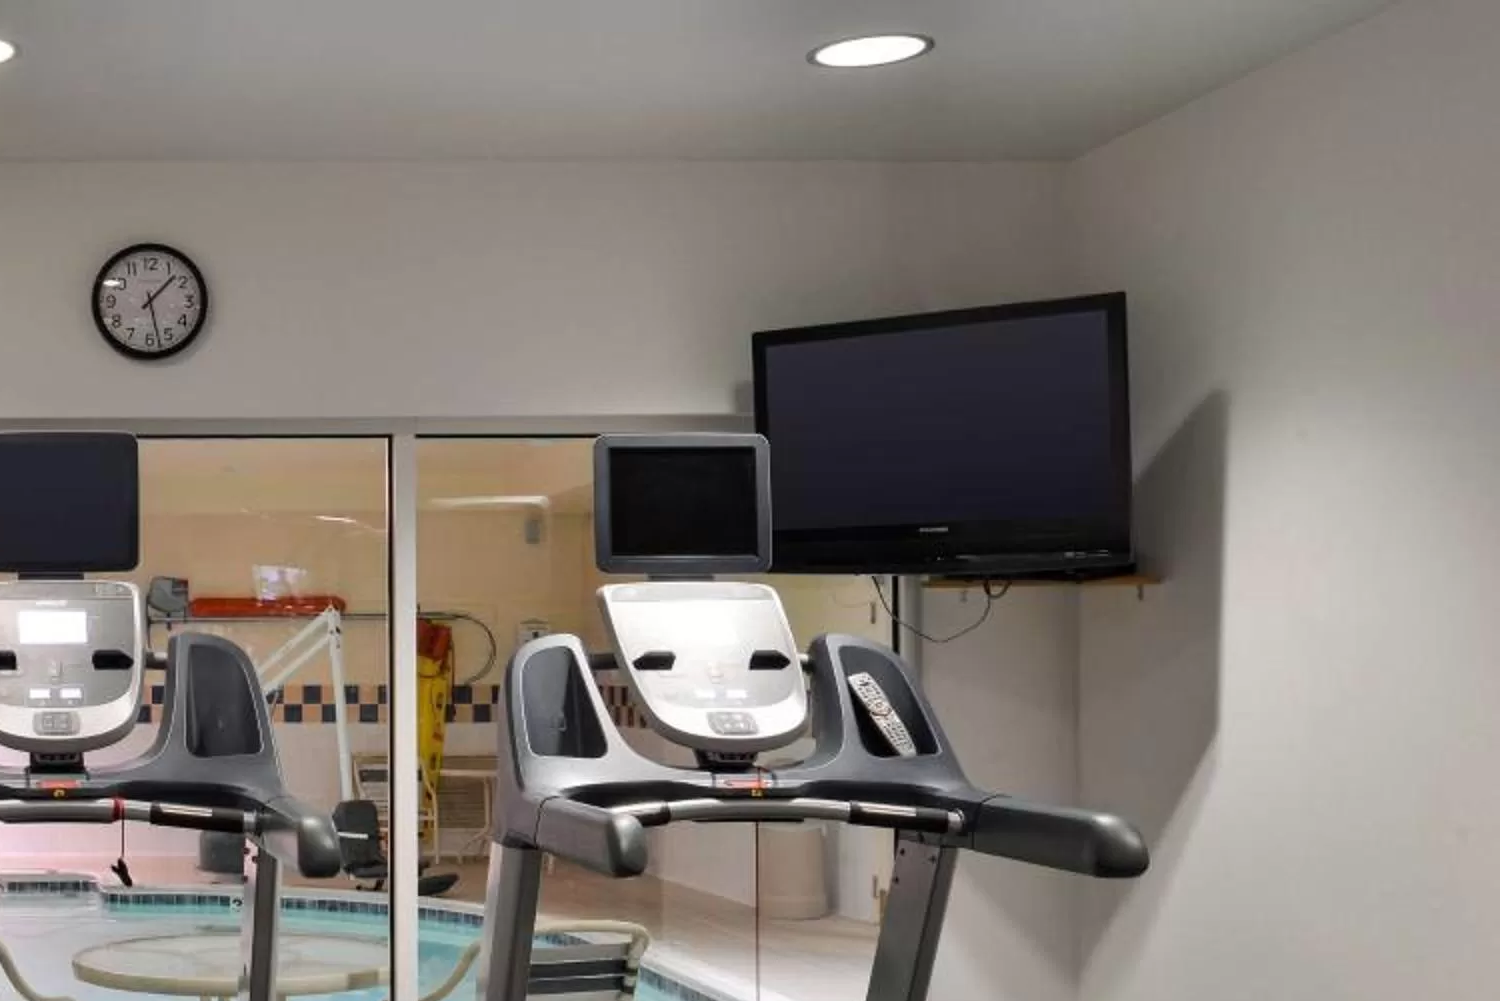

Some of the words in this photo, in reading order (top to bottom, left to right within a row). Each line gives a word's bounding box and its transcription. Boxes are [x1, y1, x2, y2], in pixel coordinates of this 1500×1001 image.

[127, 261, 137, 276] 11
[143, 257, 158, 271] 12
[165, 261, 172, 275] 1
[178, 275, 189, 289] 2
[106, 294, 117, 309] 9
[184, 295, 194, 309] 3
[111, 314, 122, 329] 8
[177, 313, 187, 326] 4
[126, 327, 135, 340] 7
[145, 333, 155, 347] 6
[163, 327, 173, 341] 5
